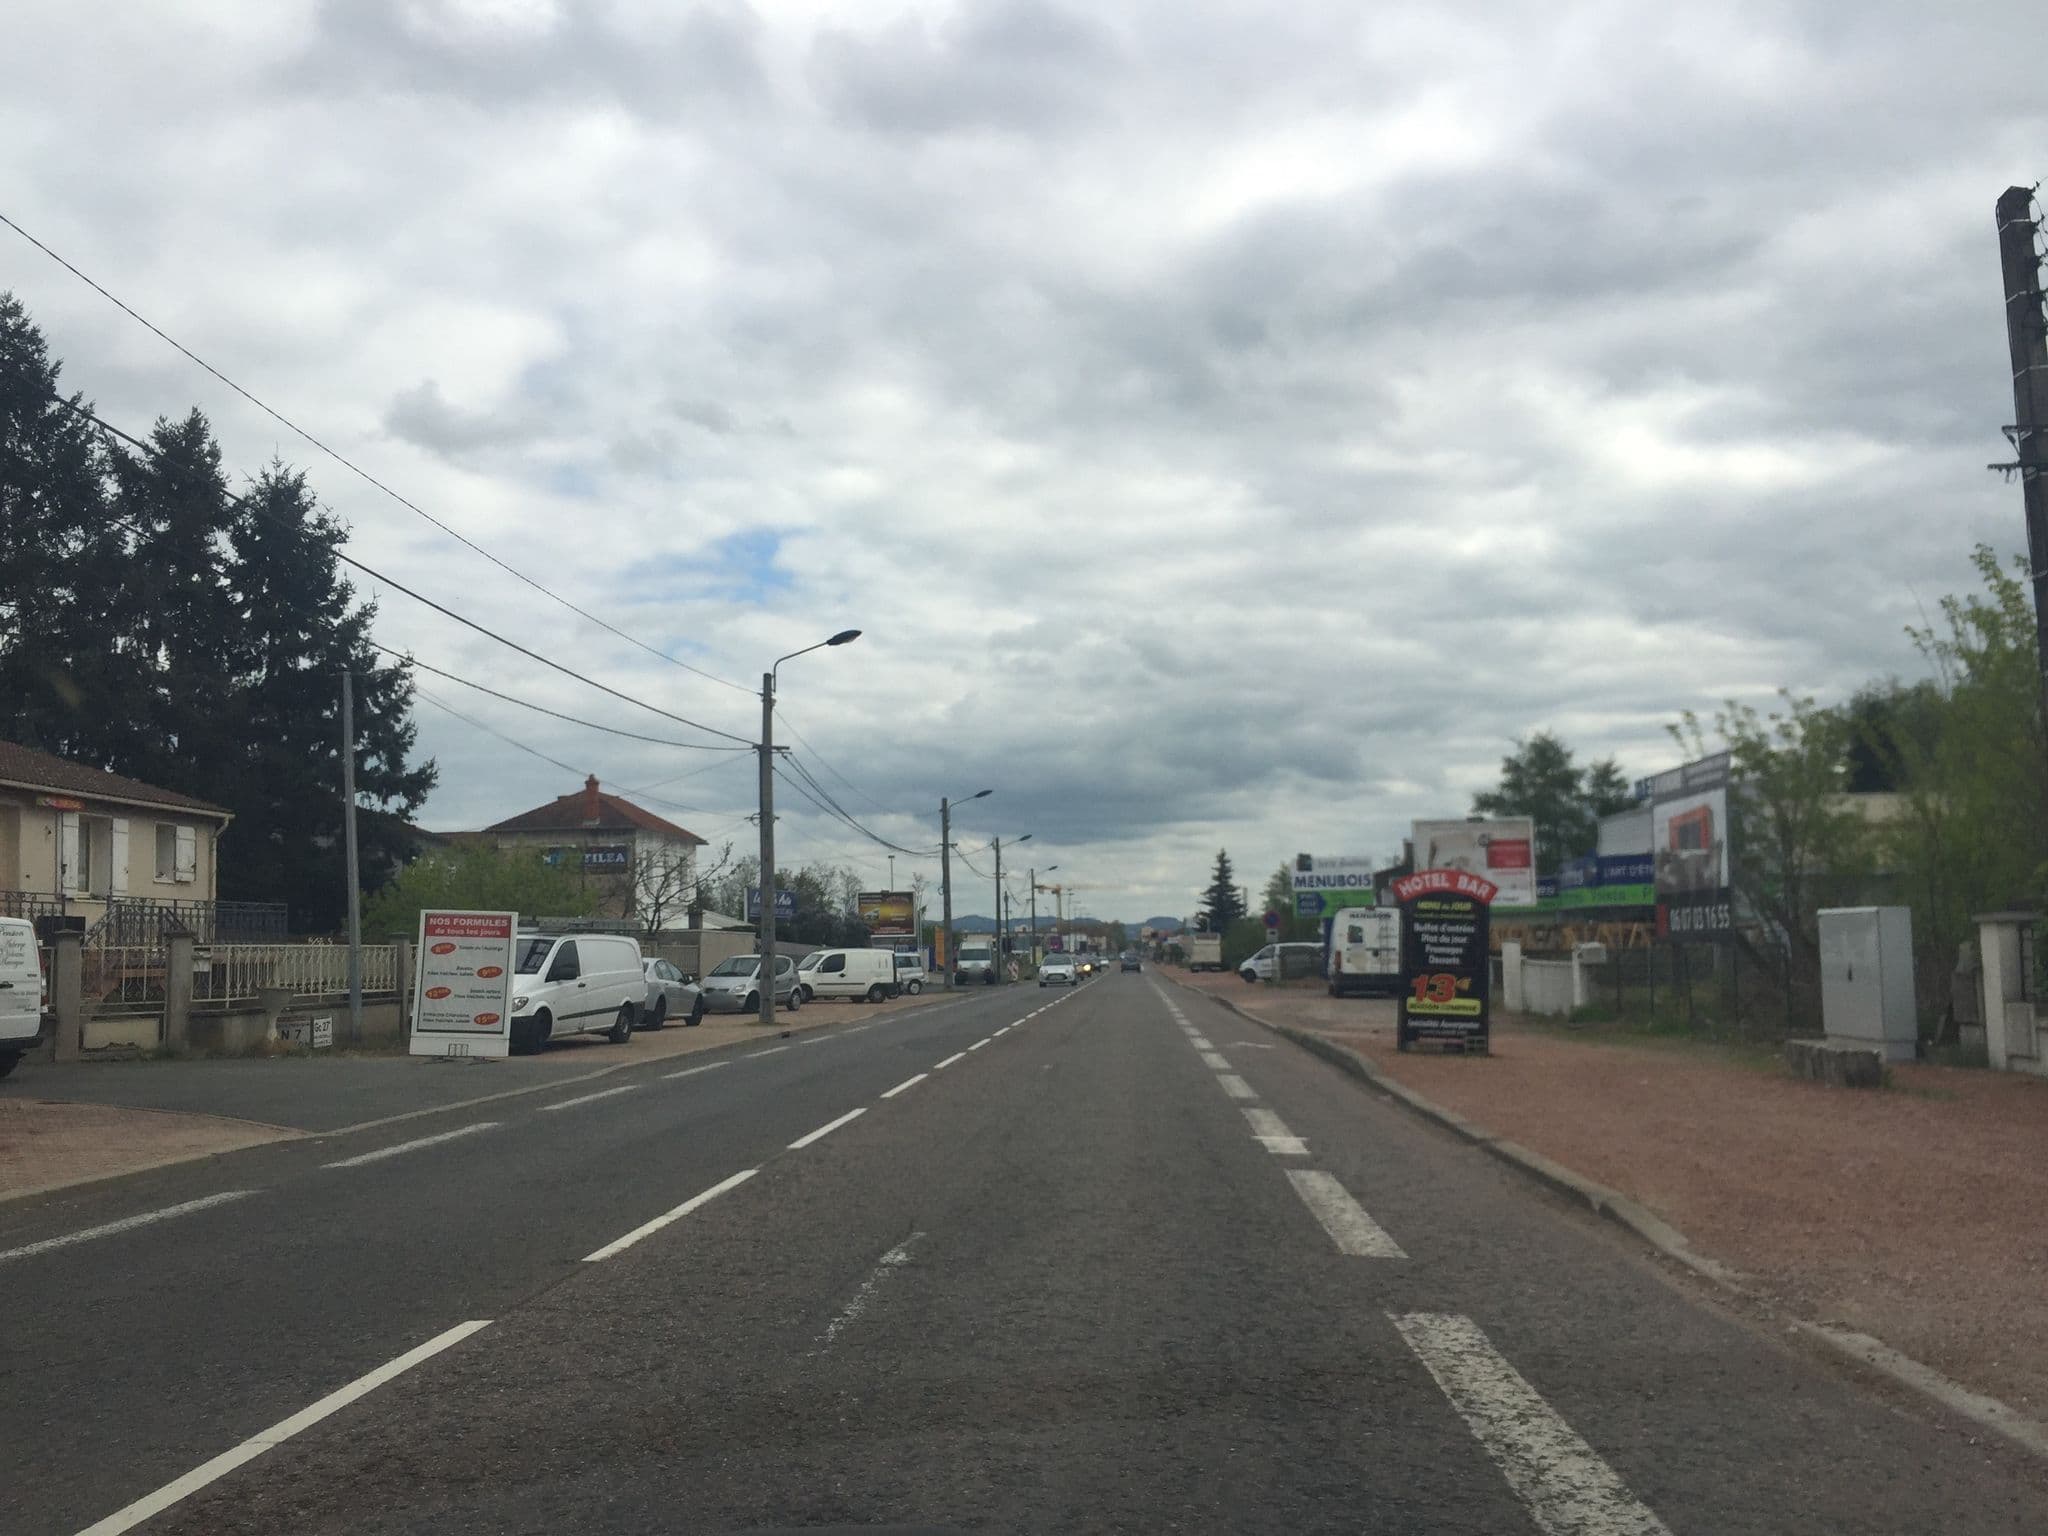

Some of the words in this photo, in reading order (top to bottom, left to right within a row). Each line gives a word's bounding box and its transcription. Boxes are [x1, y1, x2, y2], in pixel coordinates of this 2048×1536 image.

[1294, 873, 1371, 888] MENUBOIS
[1399, 873, 1450, 896] HOTEL
[1457, 874, 1490, 897] BAR
[429, 917, 450, 926] NOS
[453, 918, 508, 927] FORMULES
[435, 927, 445, 935] de
[480, 929, 501, 937] jours
[281, 1030, 290, 1041] N
[295, 1029, 302, 1040] 7
